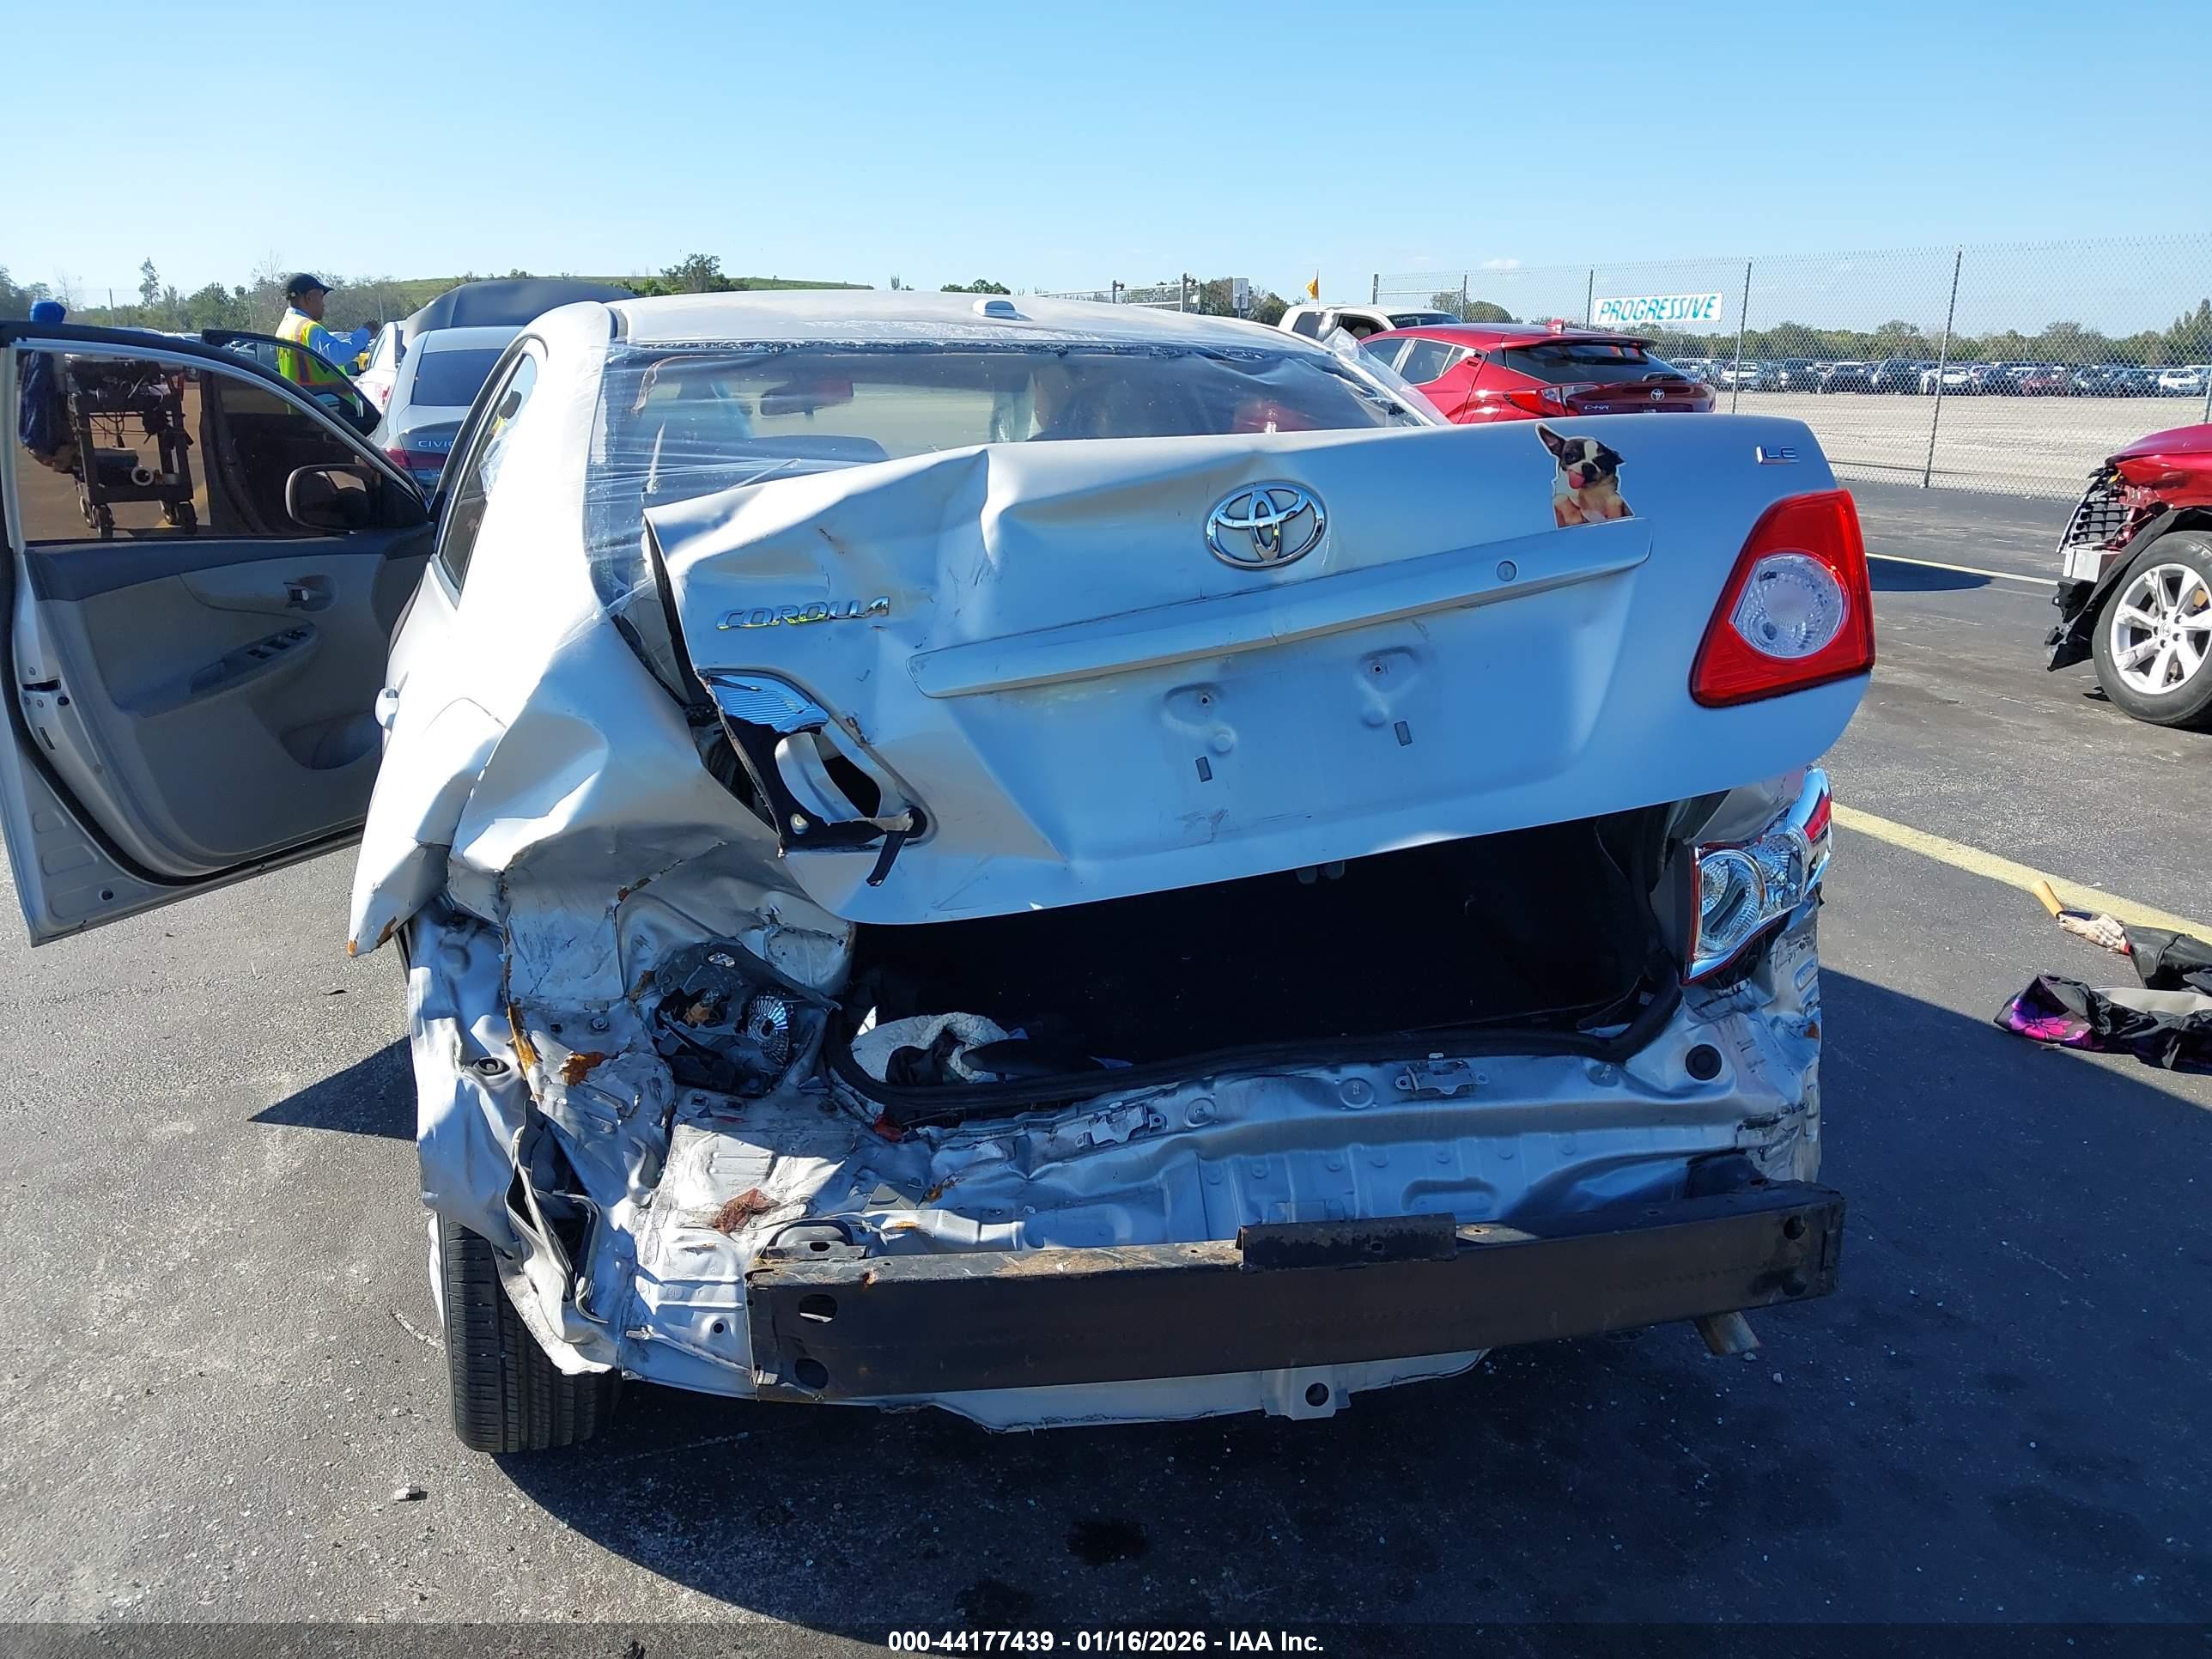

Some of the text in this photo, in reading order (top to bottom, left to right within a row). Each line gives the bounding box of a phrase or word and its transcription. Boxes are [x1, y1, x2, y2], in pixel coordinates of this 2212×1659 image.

[1597, 295, 1717, 322] PROGRESSIVE
[1759, 445, 1799, 462] LE
[716, 596, 890, 631] COROLLA
